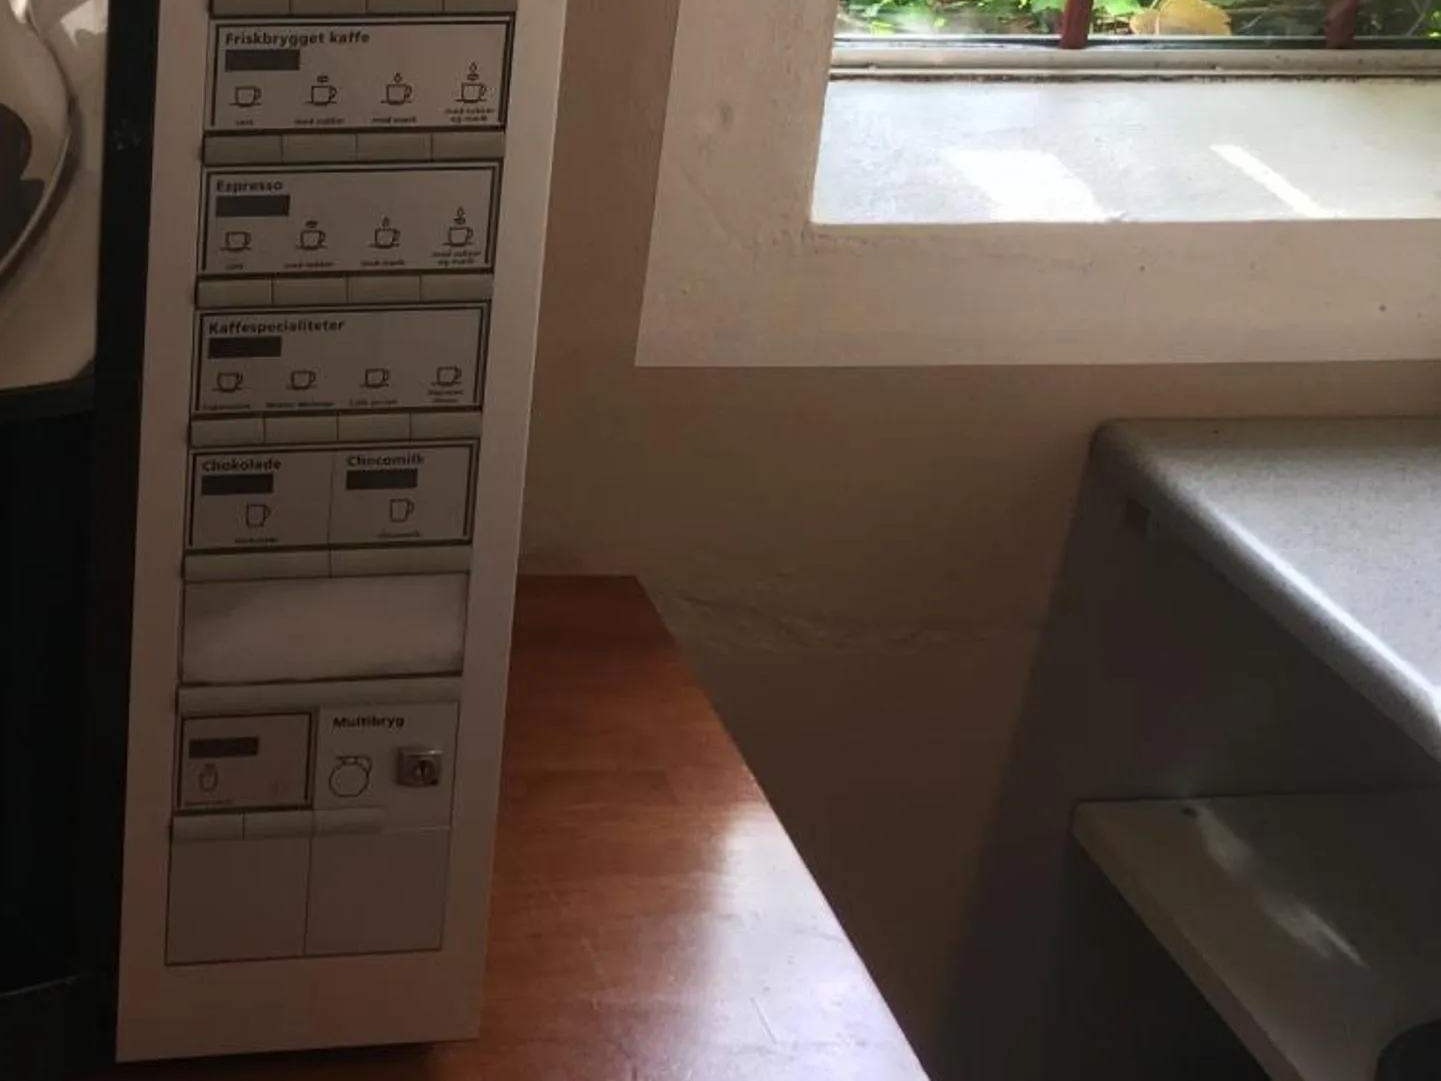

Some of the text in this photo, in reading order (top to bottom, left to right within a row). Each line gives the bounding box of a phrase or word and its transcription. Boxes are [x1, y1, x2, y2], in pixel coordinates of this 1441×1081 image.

[225, 30, 370, 48] Friskbrygget kaffe
[216, 179, 283, 193] Espresso
[209, 320, 345, 335] Kaffespecialiteter
[201, 457, 282, 471] Chokolade
[346, 453, 425, 467] Chocomilk
[333, 716, 405, 729] Multibryg
